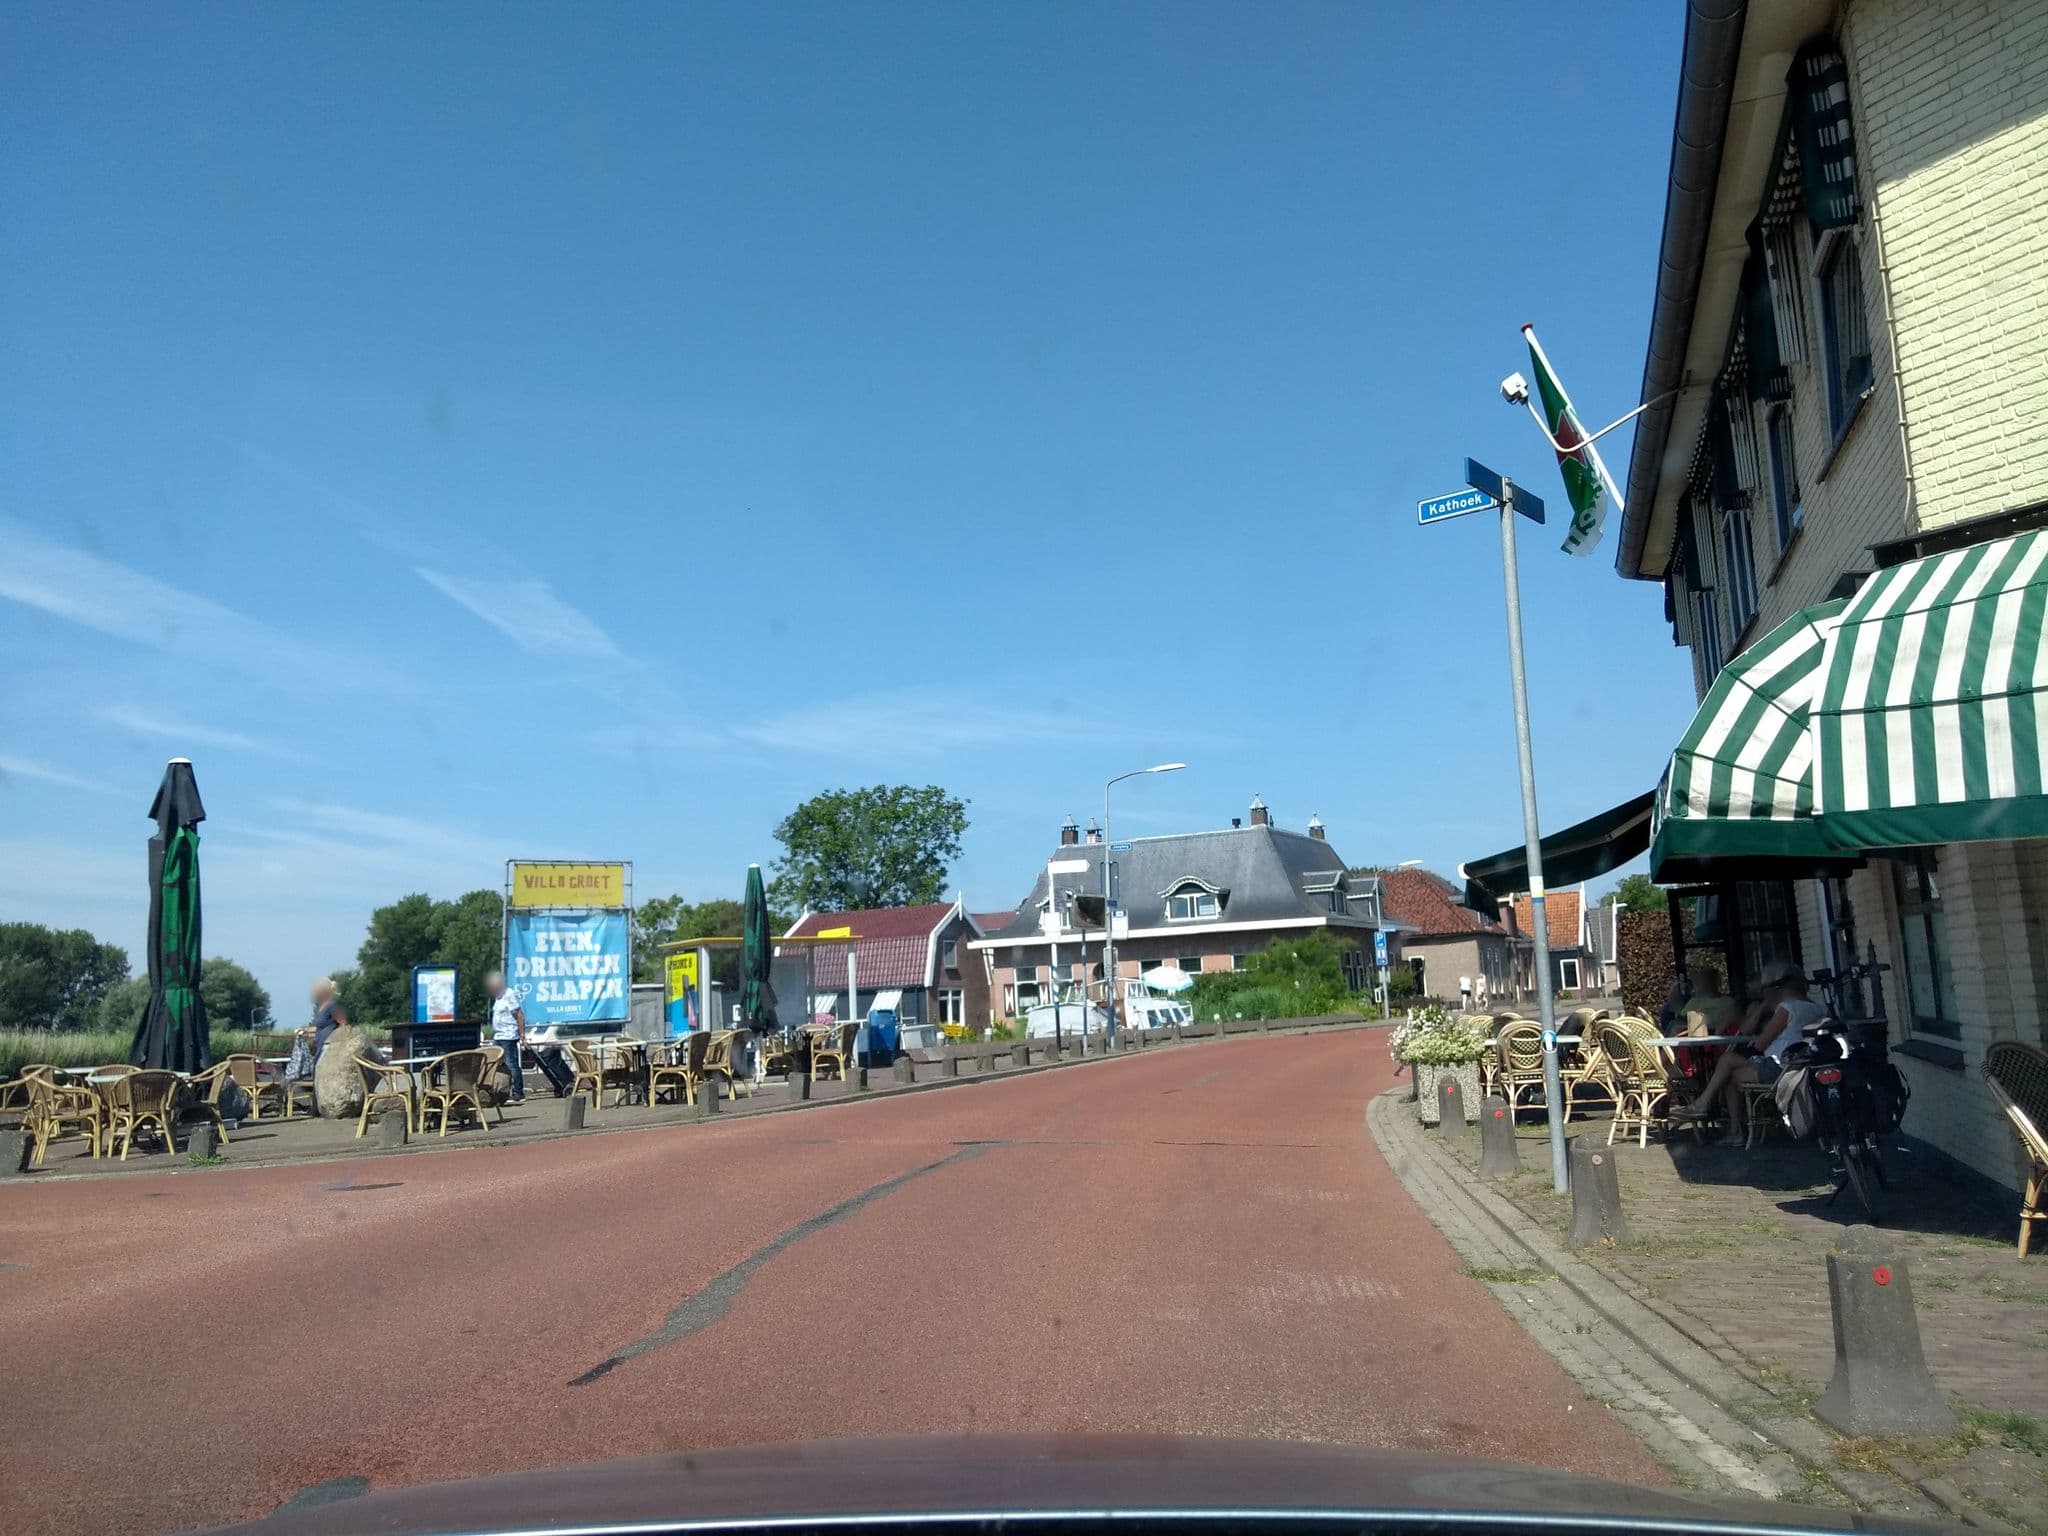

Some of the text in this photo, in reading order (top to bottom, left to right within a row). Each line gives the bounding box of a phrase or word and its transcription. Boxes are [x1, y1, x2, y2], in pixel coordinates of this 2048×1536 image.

[1429, 493, 1482, 516] Kathoek
[535, 931, 600, 953] ETEN,
[514, 954, 620, 977] DRINKEN
[536, 978, 622, 1002] SLAPEN
